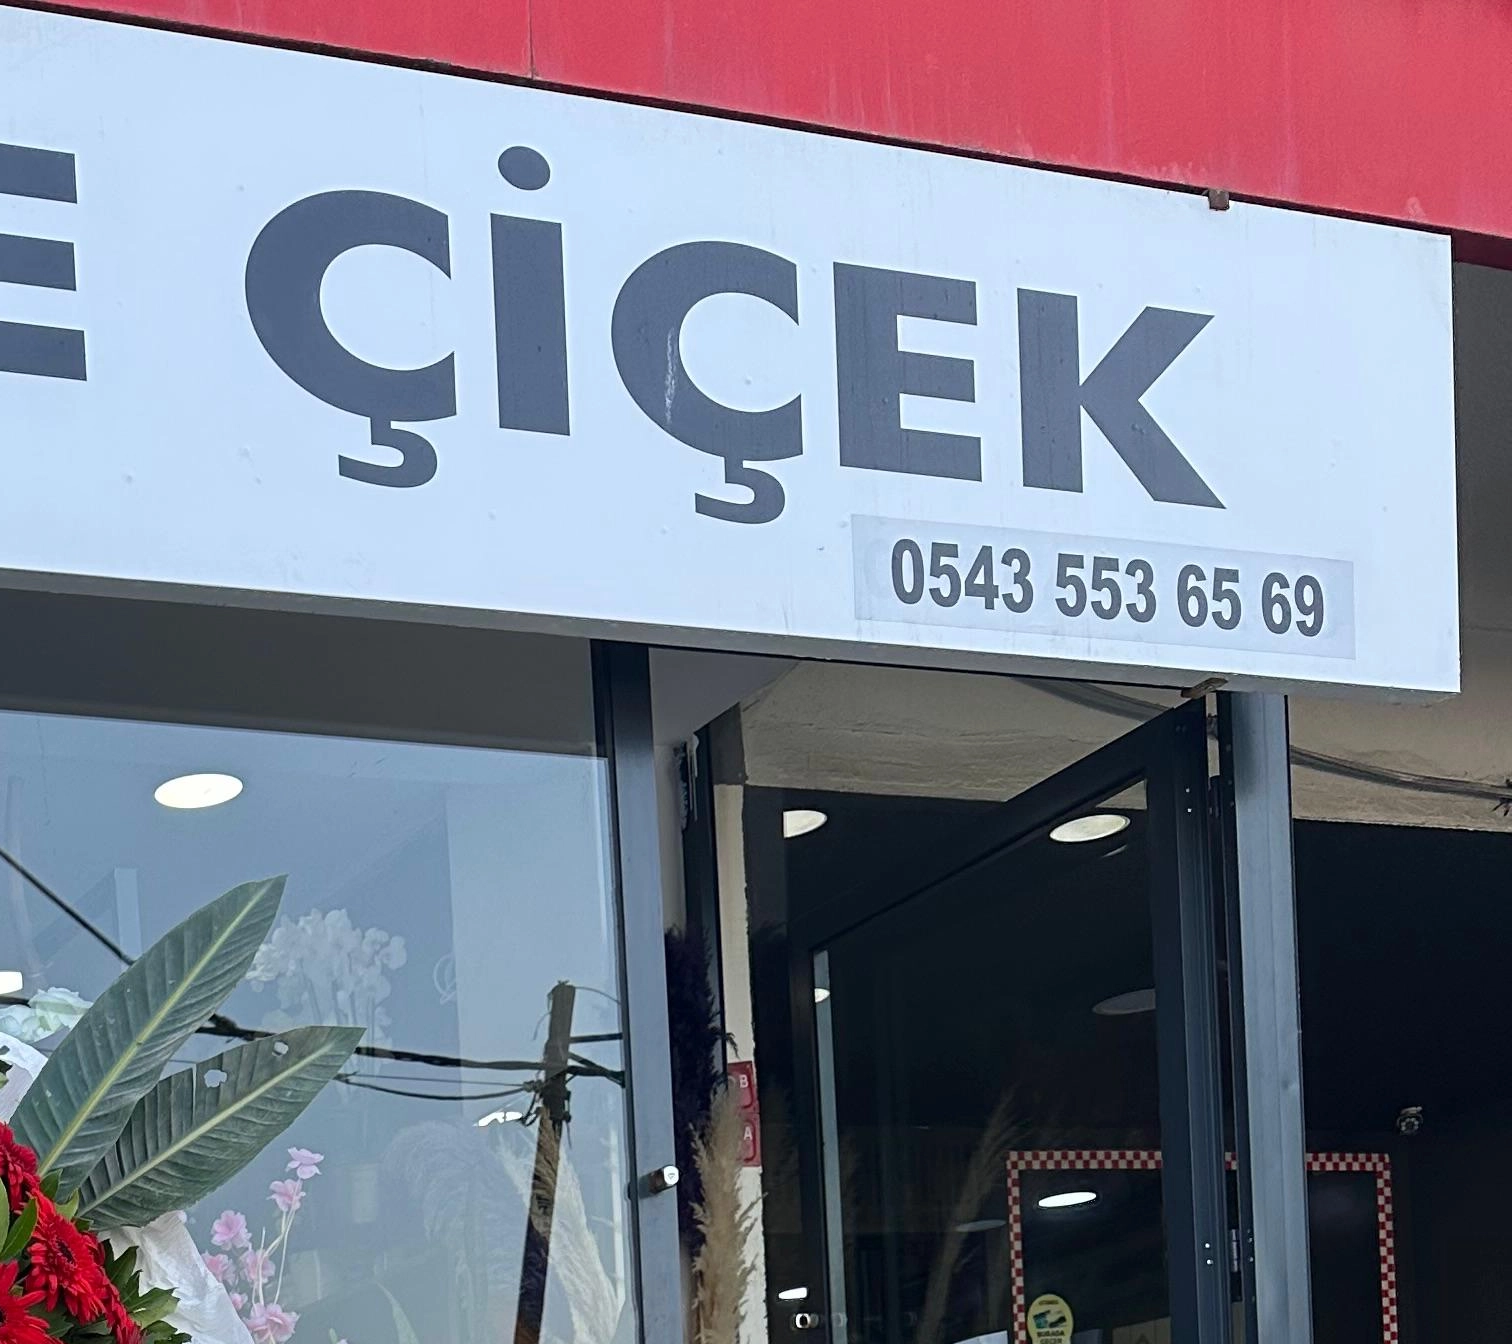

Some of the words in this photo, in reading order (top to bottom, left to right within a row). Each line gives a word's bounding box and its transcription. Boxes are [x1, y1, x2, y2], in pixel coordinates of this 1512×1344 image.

[245, 146, 1226, 524] ÇİÇEK
[892, 539, 1034, 613] 0543
[1055, 553, 1157, 623] 553
[1177, 564, 1242, 630] 65
[1262, 572, 1324, 637] 69
